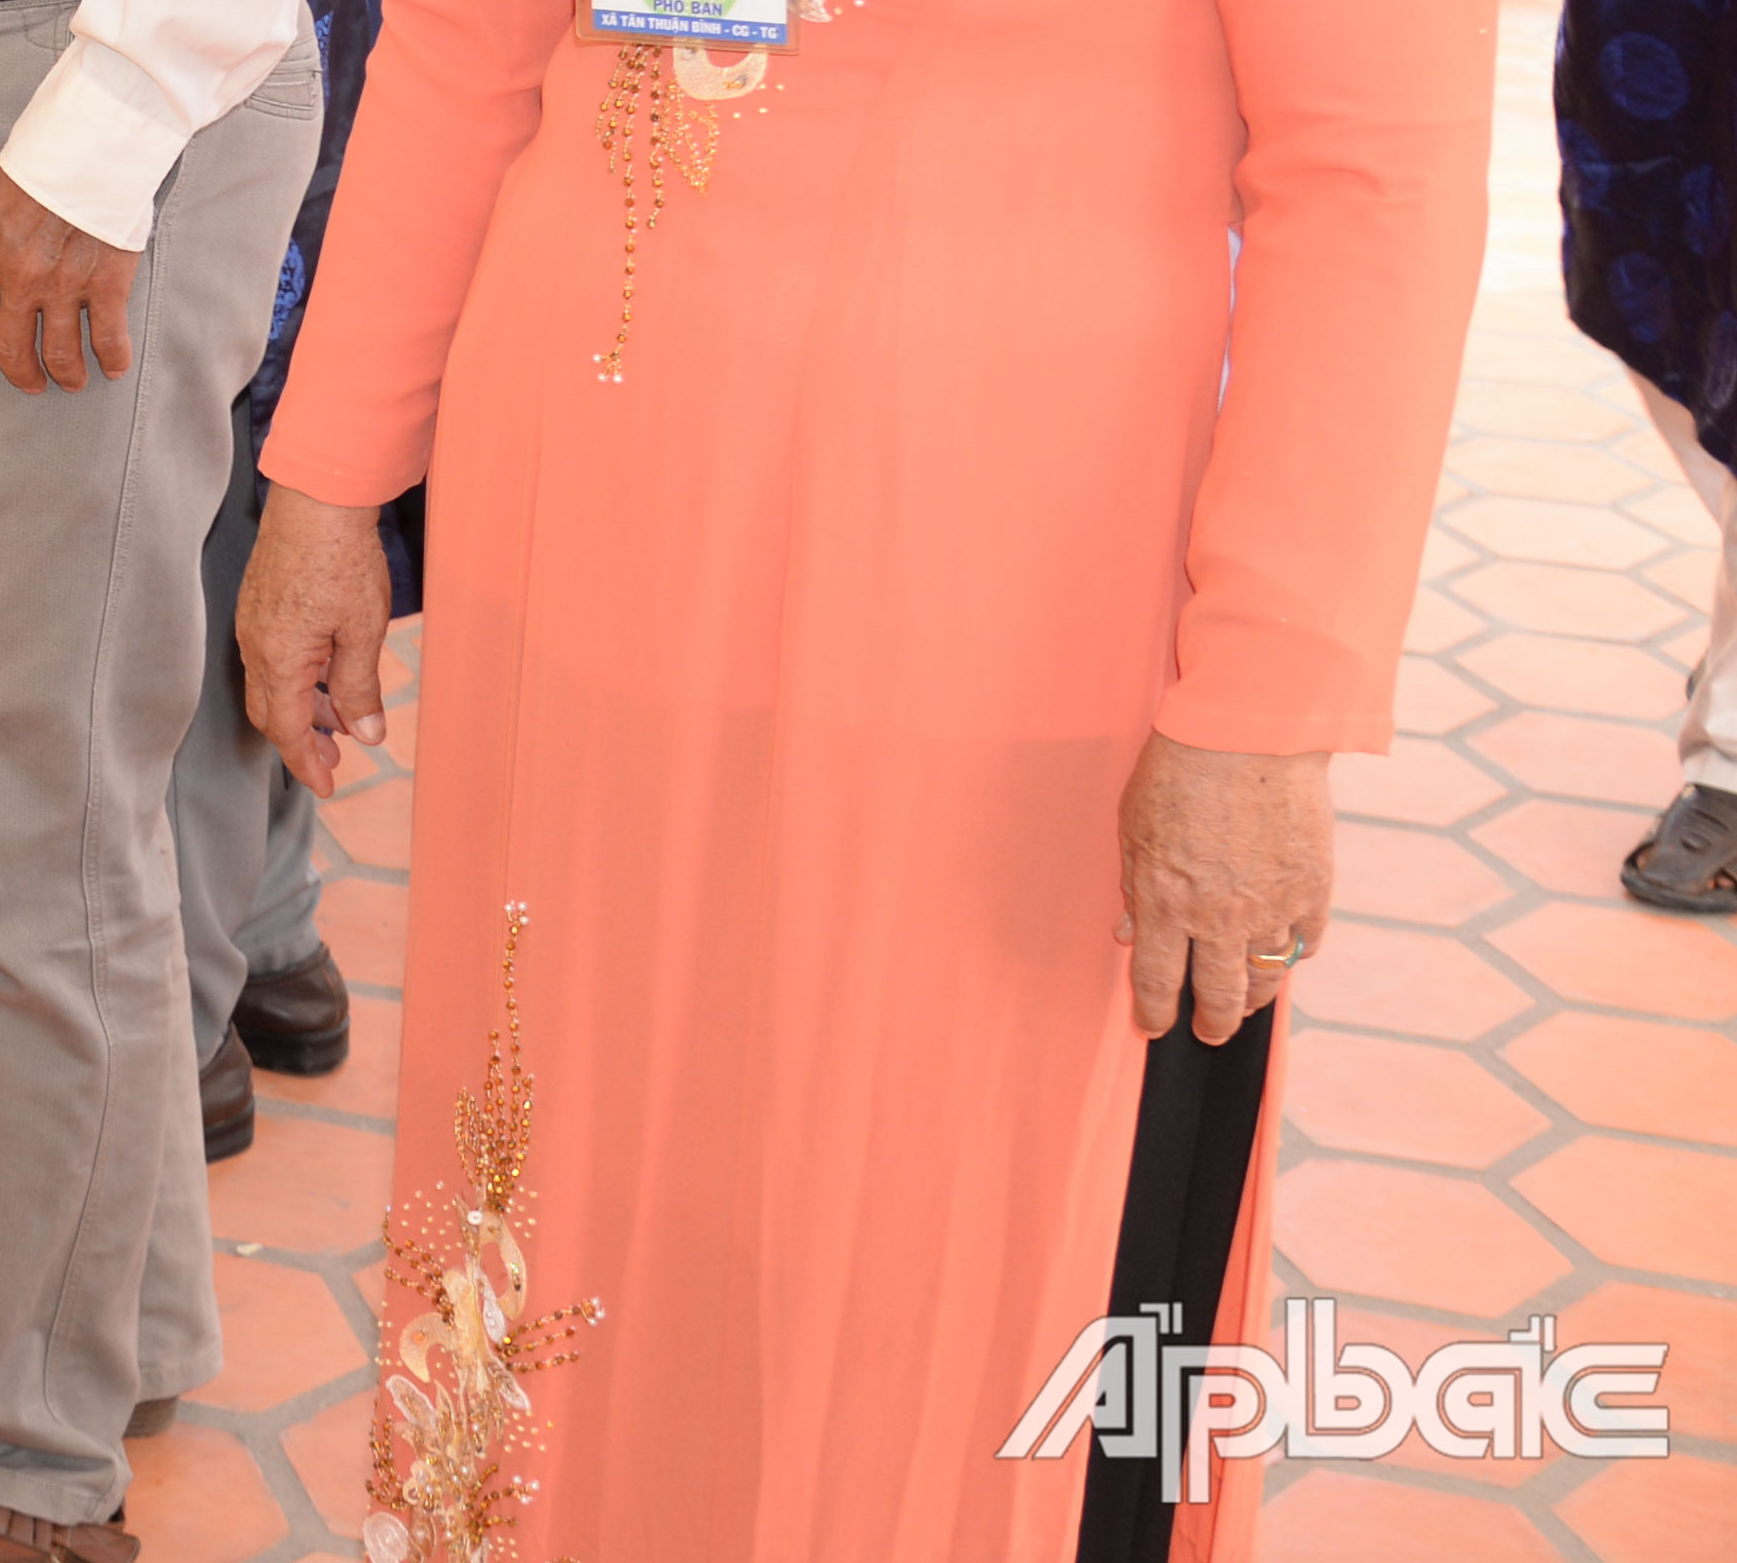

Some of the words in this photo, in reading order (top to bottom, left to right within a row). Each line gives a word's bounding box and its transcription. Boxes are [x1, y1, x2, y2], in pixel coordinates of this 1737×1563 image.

[691, 1, 722, 16] BAN
[601, 13, 617, 27] XÃ
[621, 14, 645, 28] TÂN
[648, 16, 688, 33] THUẬN
[691, 18, 721, 35] BÌNH
[732, 24, 750, 37] CG
[760, 26, 778, 40] TG
